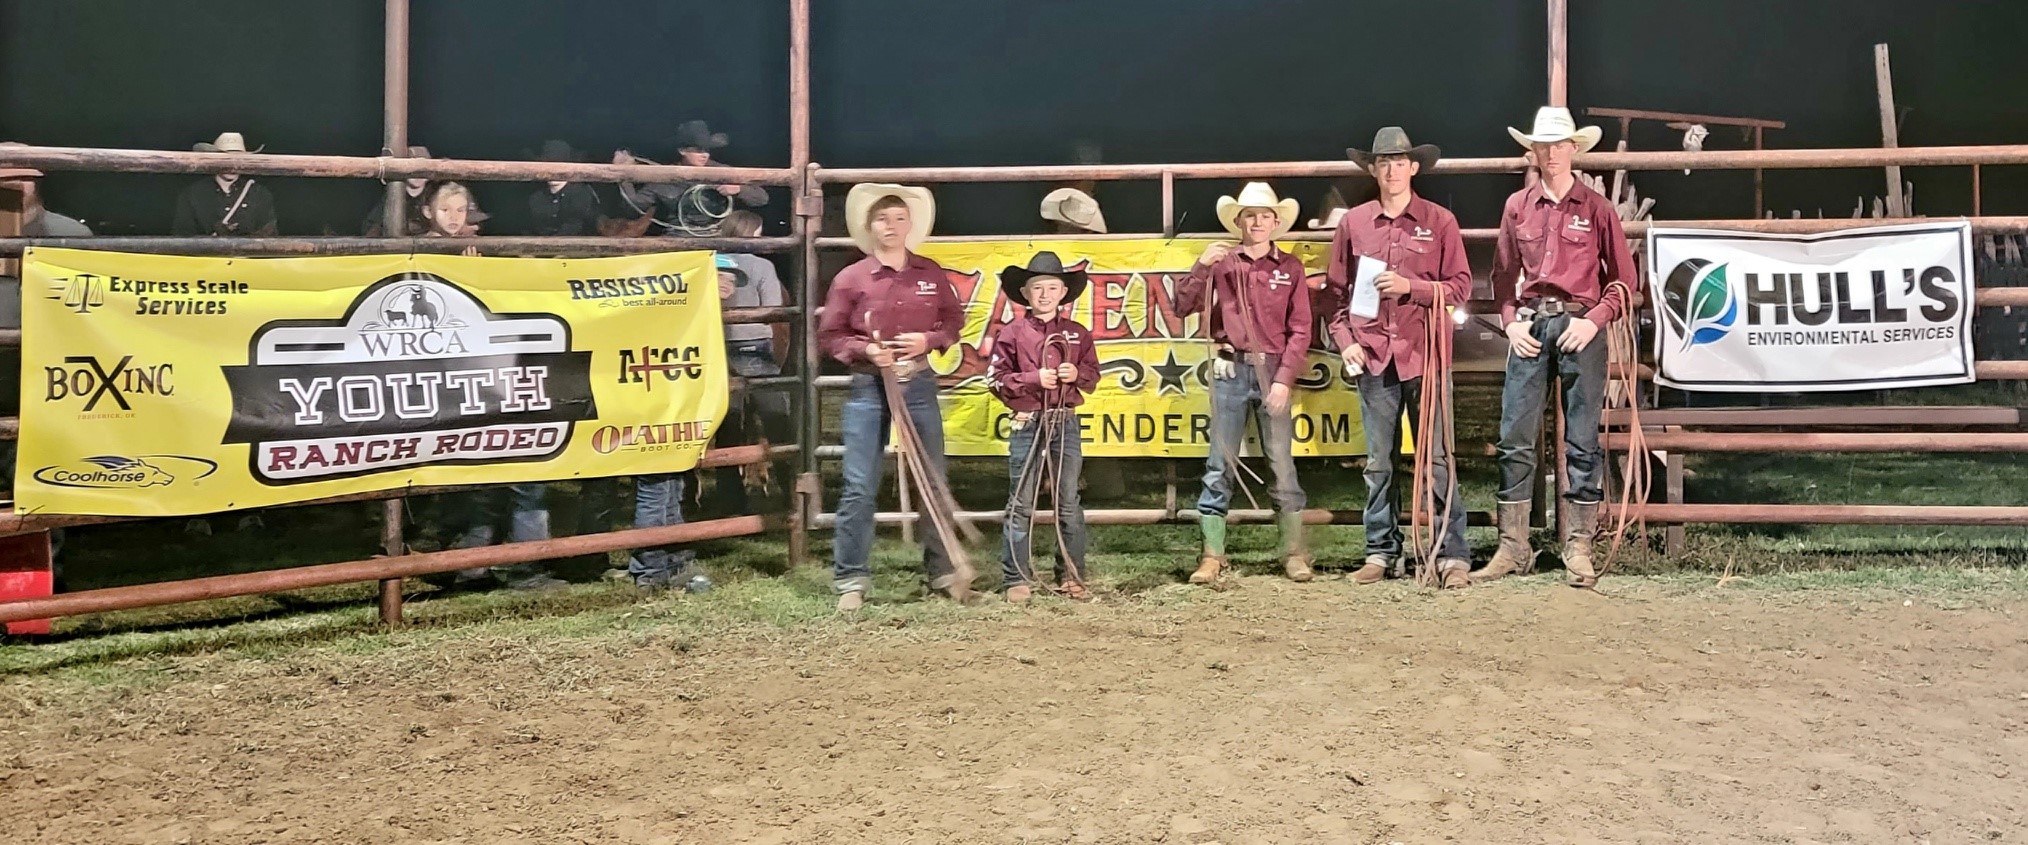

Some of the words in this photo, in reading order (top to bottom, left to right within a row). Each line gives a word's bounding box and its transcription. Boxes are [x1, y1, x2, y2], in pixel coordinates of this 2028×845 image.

[109, 276, 190, 295] Express
[197, 279, 249, 294] Scale
[566, 273, 688, 299] RESISTOL
[1745, 265, 1959, 326] HULL'S
[135, 296, 227, 315] Services
[645, 297, 687, 306] all-around
[359, 329, 469, 357] WRCA
[1748, 329, 1878, 346] ENVIRONMENTAL
[1884, 326, 1955, 343] SERVICES
[279, 366, 551, 426] YOUTH
[268, 440, 418, 472] RANCH
[432, 427, 559, 456] RODEO
[592, 420, 713, 454] OLATHE
[54, 470, 145, 482] Coolhorse
